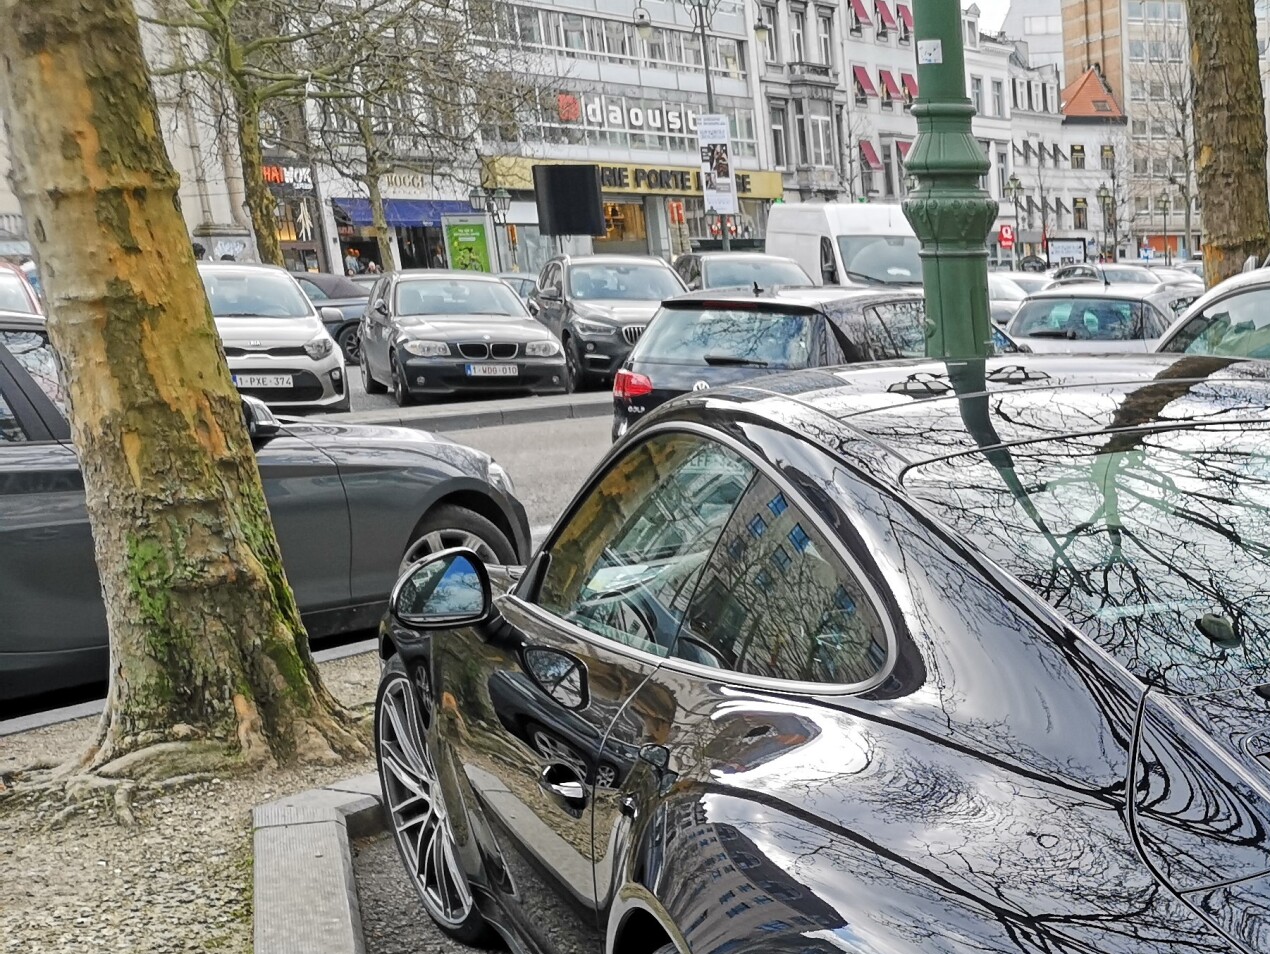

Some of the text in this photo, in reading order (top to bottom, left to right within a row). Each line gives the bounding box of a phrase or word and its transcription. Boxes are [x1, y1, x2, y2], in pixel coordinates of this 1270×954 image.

[586, 95, 699, 132] daoust
[634, 168, 692, 191] PORTE
[239, 376, 291, 387] 1-PXE-374
